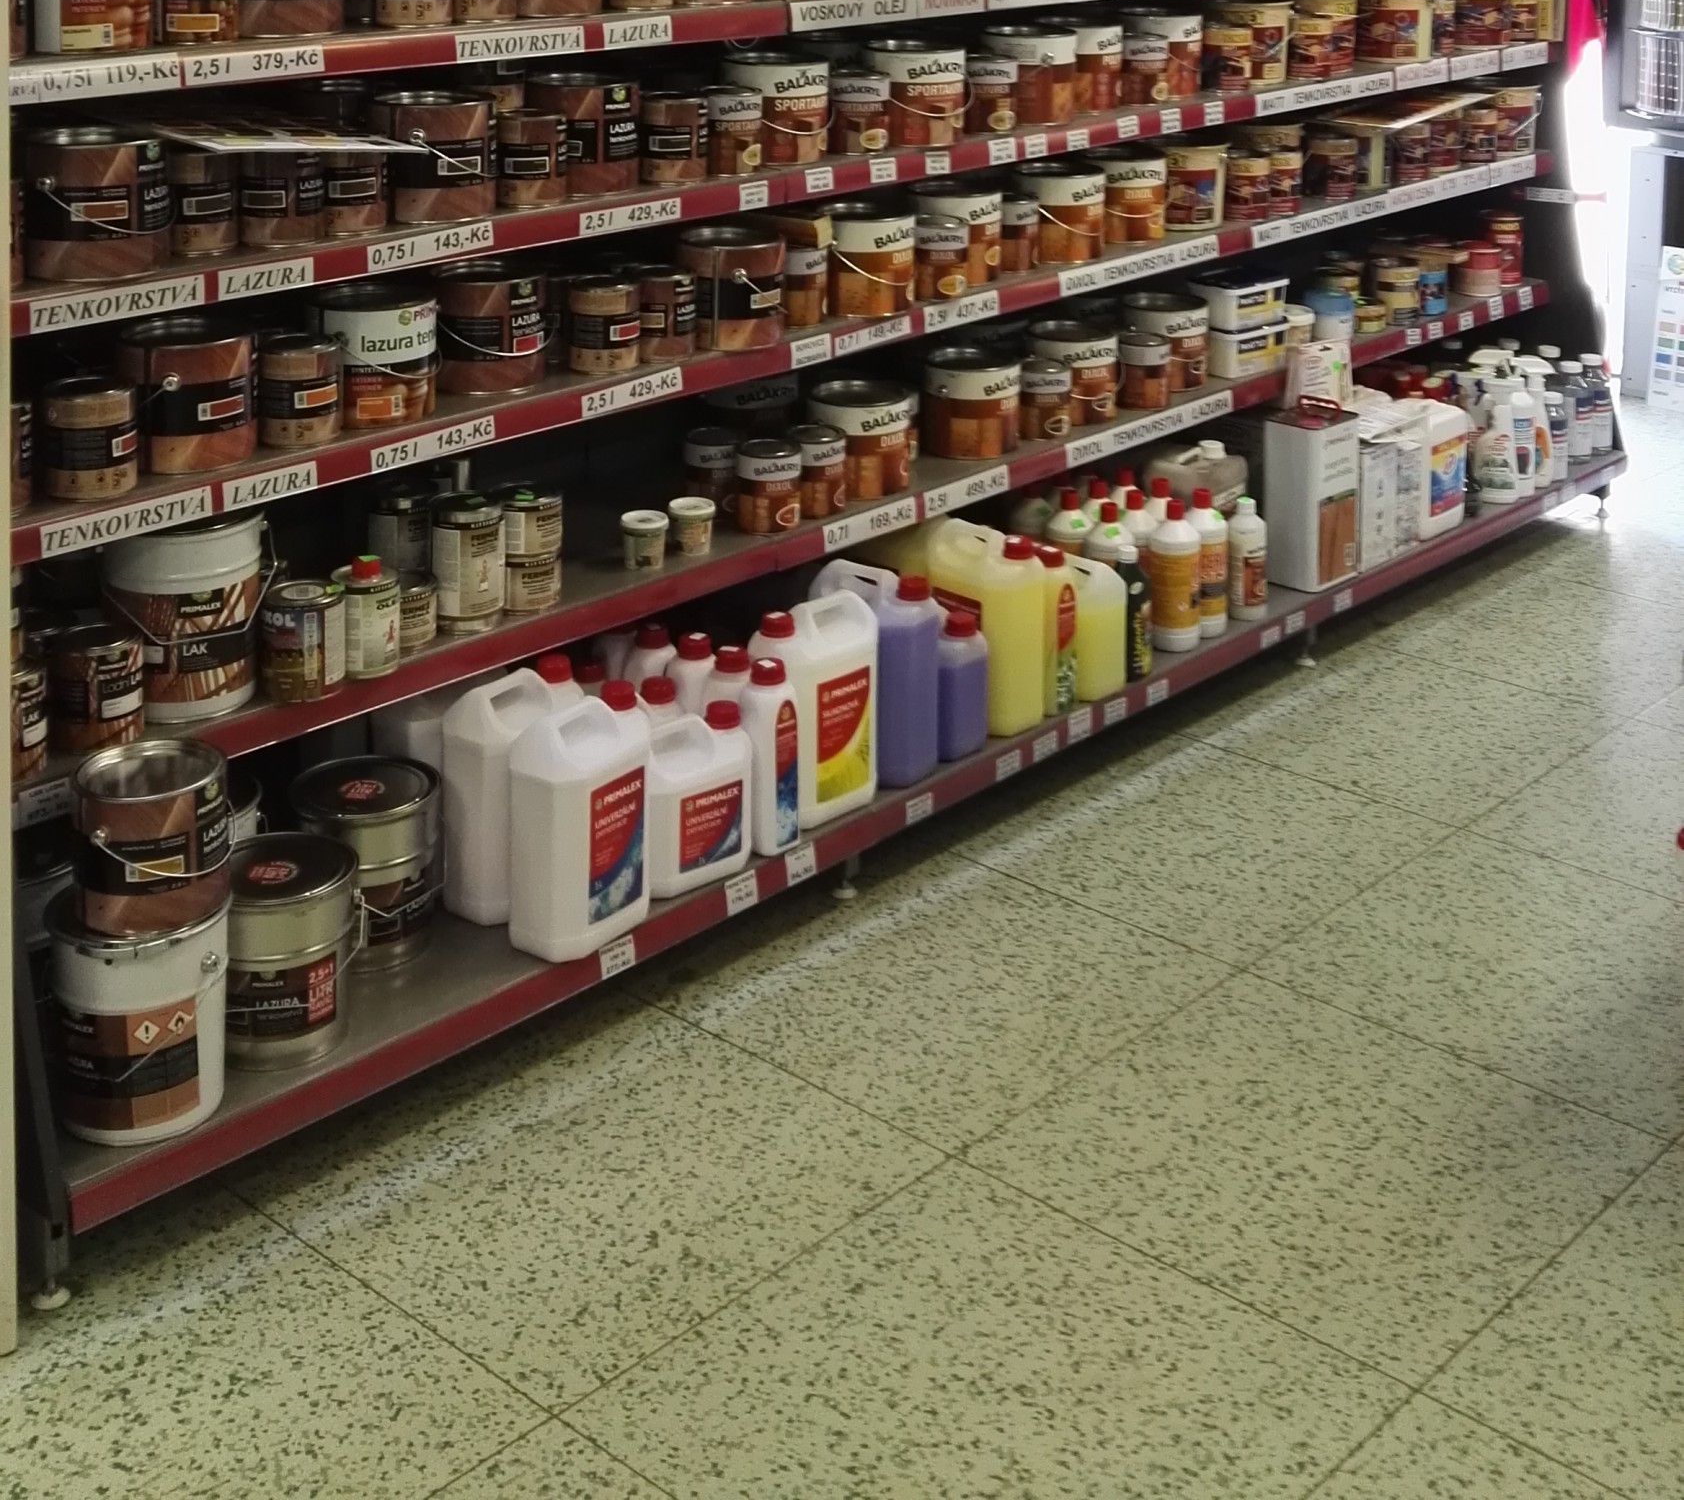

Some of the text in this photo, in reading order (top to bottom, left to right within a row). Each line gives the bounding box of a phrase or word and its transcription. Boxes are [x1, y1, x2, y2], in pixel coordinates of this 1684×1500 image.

[800, 1, 864, 23] VOSKOVÝ
[874, 0, 907, 16] OLEJ
[458, 22, 670, 58] TENKOVRSTVÁ LAZURA
[105, 61, 180, 85] 119,-Kč
[252, 48, 319, 71] 379,-Kč
[609, 121, 636, 134] LAZURA
[628, 202, 678, 223] 429,-Kč
[434, 227, 491, 251] 143,-Kč
[33, 264, 306, 328] TENKOVRSTVÁ LAZURA
[512, 313, 542, 327] LAZURA
[361, 333, 414, 354] lazura
[629, 374, 679, 399] 429,-Kč
[437, 421, 493, 450] 143,-Kč
[43, 468, 312, 552] TENKOVRSTVÁ LAZURA
[180, 601, 222, 613] PRIMALEX
[182, 643, 208, 656] LAK
[22, 711, 40, 726] LAK
[603, 779, 642, 805] PRIMALEX
[695, 787, 740, 808] PRIMALEX
[256, 997, 300, 1008] LAZURA
